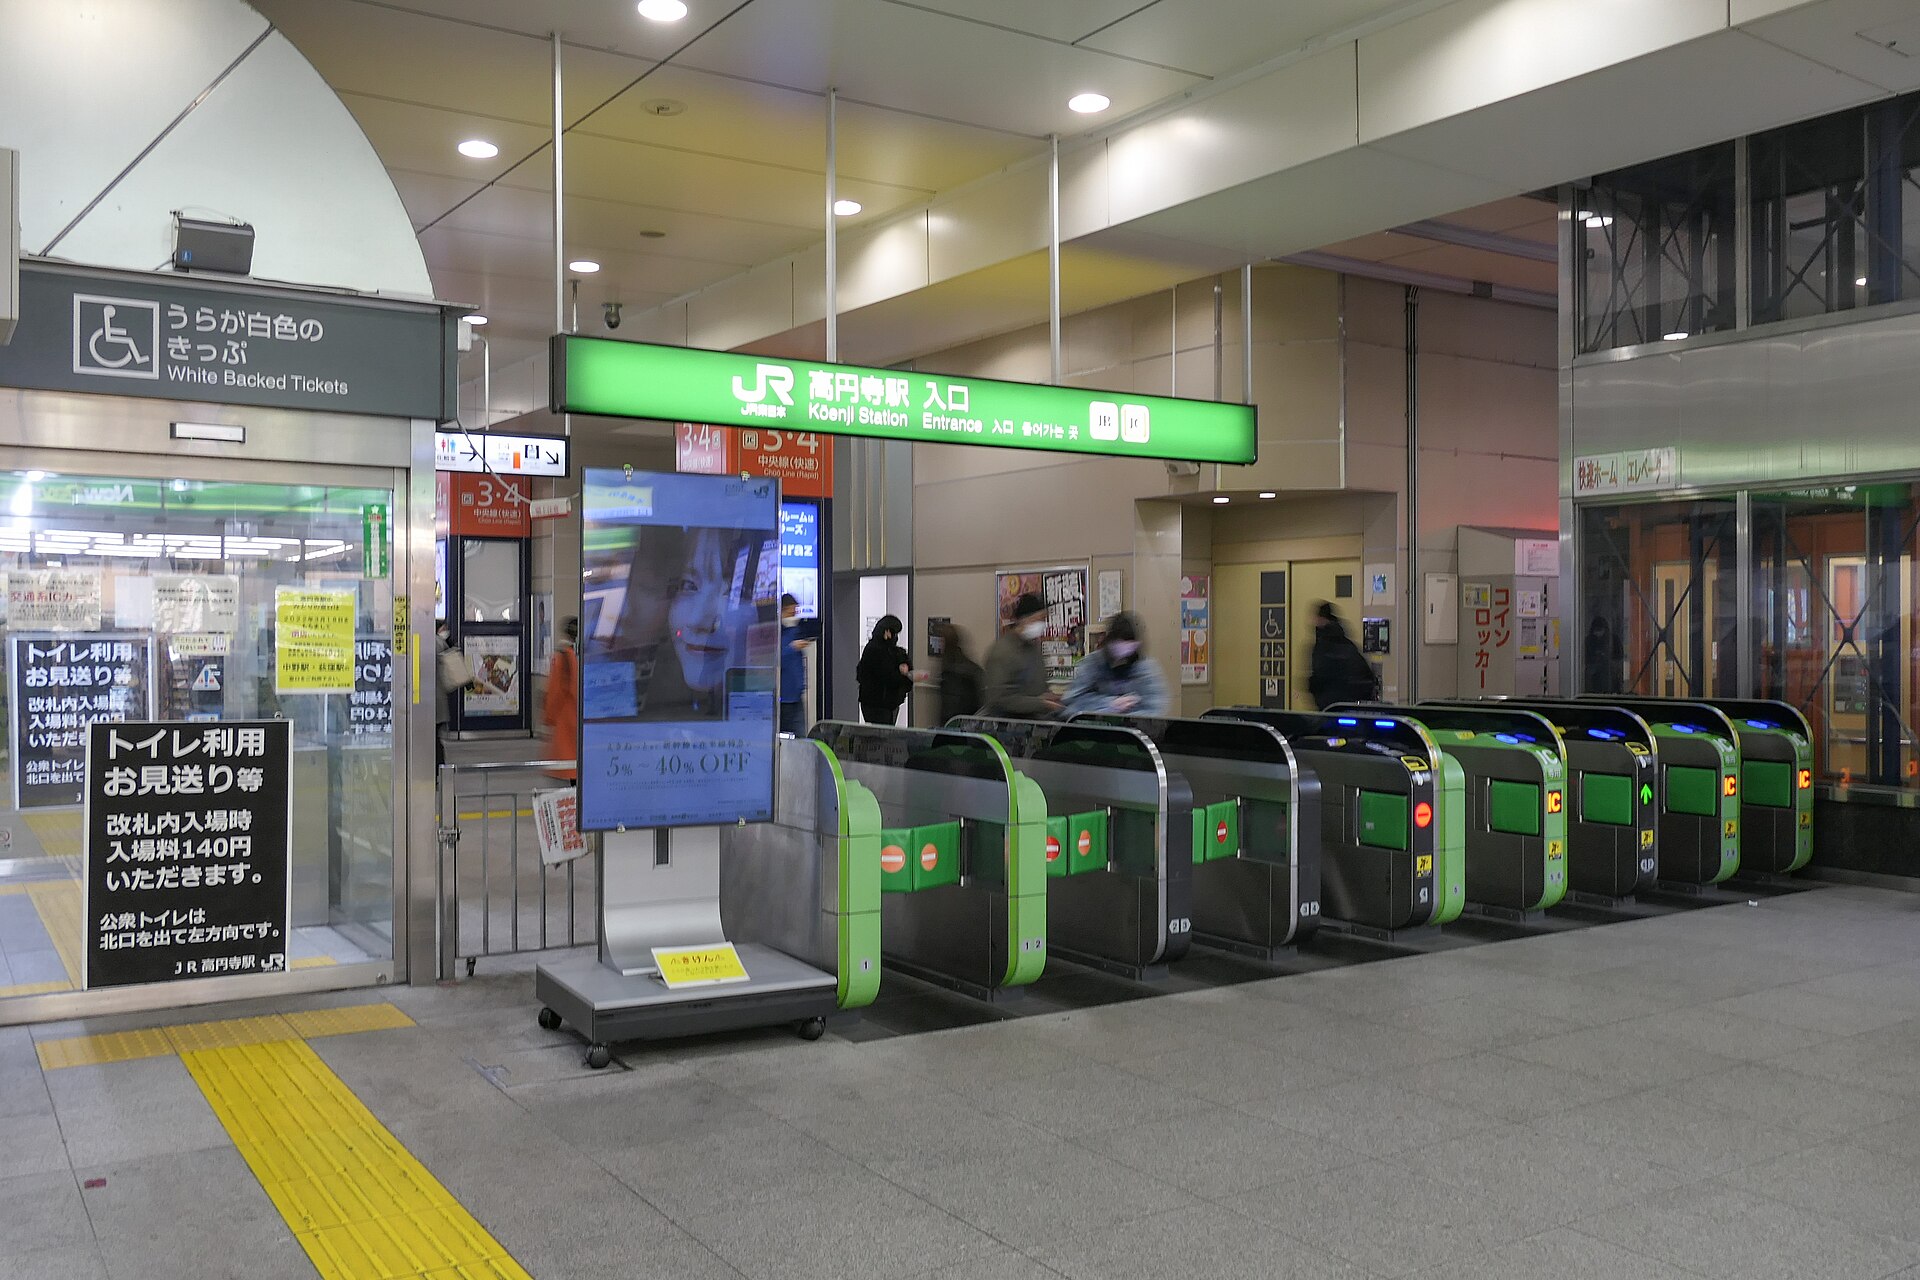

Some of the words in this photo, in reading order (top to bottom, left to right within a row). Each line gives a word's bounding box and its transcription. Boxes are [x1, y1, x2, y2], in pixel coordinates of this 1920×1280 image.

[167, 303, 324, 342] うらが白色の
[167, 335, 248, 365] きっぷ
[167, 364, 218, 386] White
[223, 369, 287, 392] Backed
[290, 374, 349, 395] Tickets
[731, 363, 795, 406] JR
[808, 369, 910, 408] 高円寺駅
[923, 381, 970, 413] 入口
[858, 406, 908, 428] Station
[922, 411, 983, 434] Entrance
[991, 418, 1014, 435] 入口
[1493, 588, 1511, 648] コイン
[28, 642, 133, 664] トイレ利用
[1475, 608, 1491, 689] ロッカー
[25, 664, 132, 688] お見送り等
[28, 686, 127, 713] 改札内入場時
[108, 727, 267, 760] トイレ利用
[699, 751, 751, 774] OFF
[103, 763, 264, 797] お見送り等
[1723, 775, 1737, 796] IC
[1798, 769, 1811, 789] IC
[1547, 791, 1562, 813] IC
[106, 808, 253, 837] 改札内入場時
[106, 834, 252, 864] 入場料140円
[106, 861, 263, 892] いただきます。
[99, 907, 206, 932] 公衆トイレは
[99, 920, 280, 951] 北口を出て左方向です。
